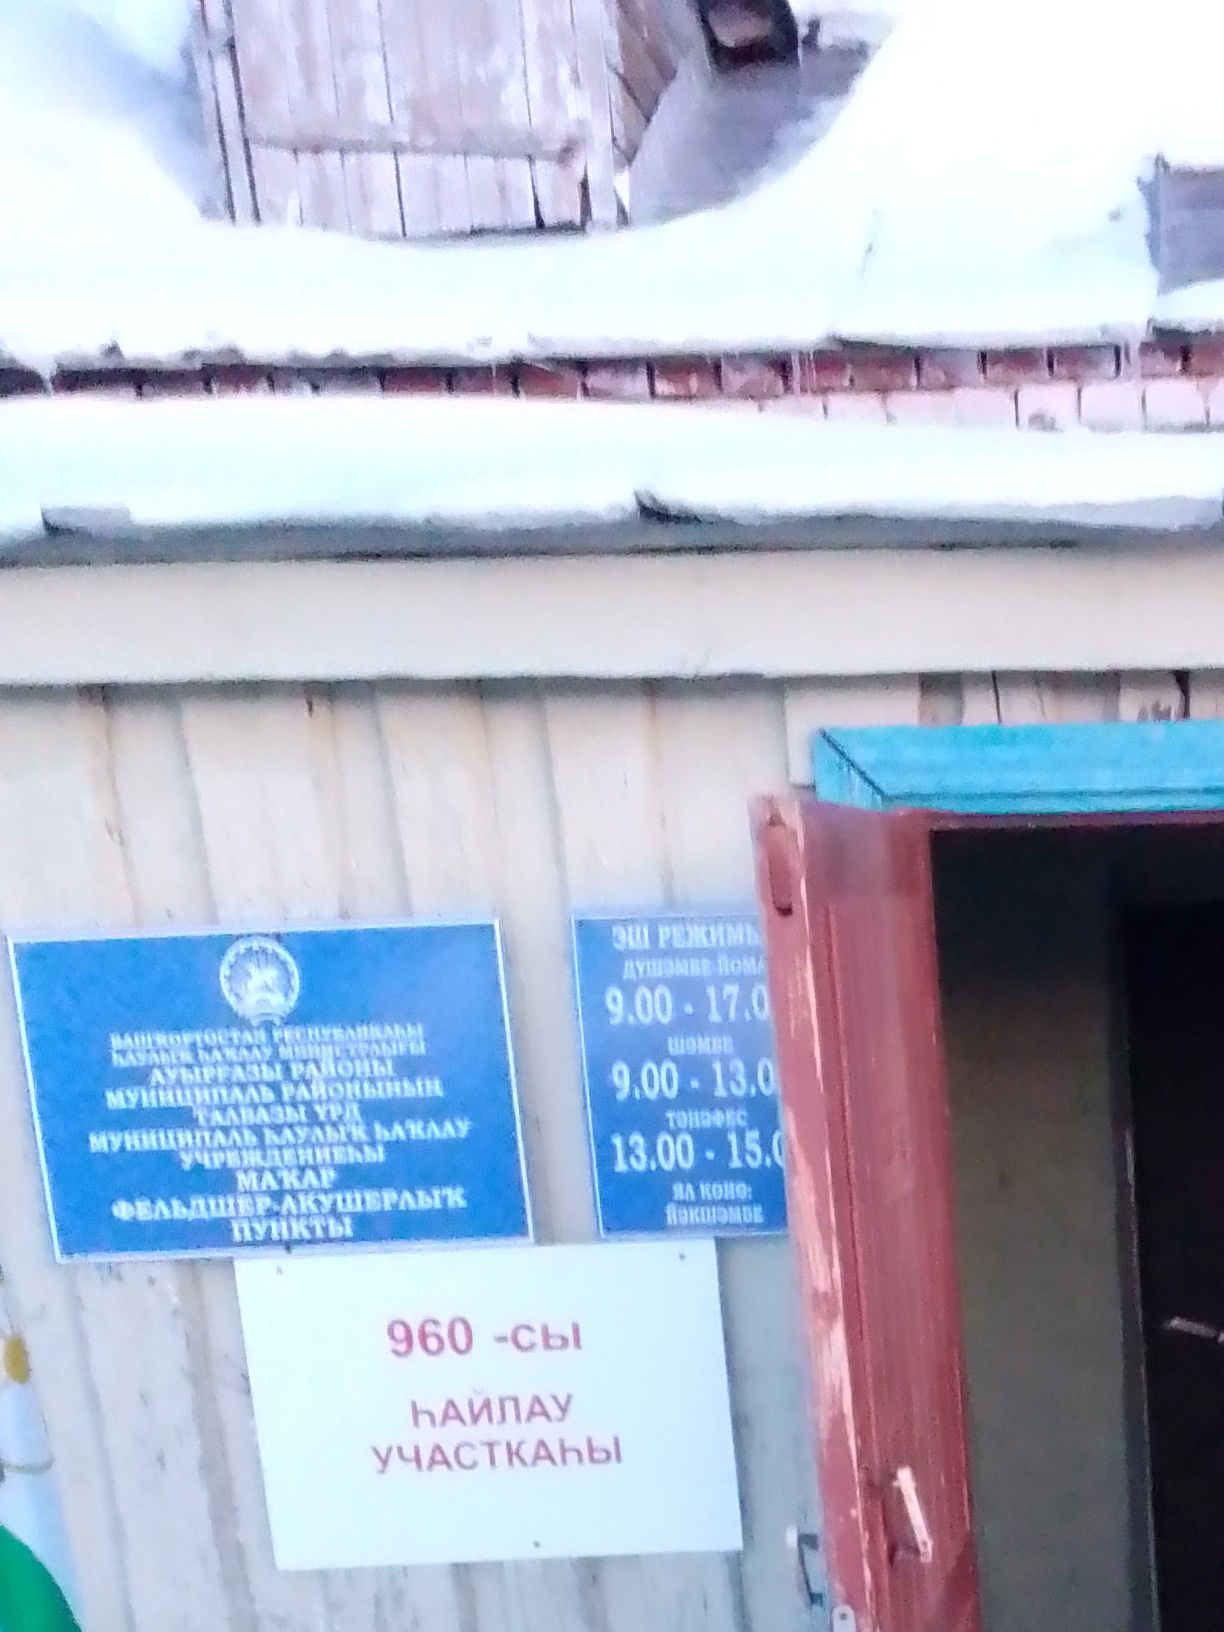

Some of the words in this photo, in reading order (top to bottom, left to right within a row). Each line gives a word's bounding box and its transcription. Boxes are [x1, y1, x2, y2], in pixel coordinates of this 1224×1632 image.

[611, 924, 650, 951] ЭШ
[605, 985, 673, 1026] 9.00
[706, 983, 770, 1024] 17.0
[289, 1056, 395, 1081] РАЙОНЫ
[611, 1060, 679, 1101] 9.00
[712, 1057, 775, 1099] 13.0
[610, 1130, 695, 1174] 13.00
[727, 1129, 784, 1169] 15.0
[672, 1182, 696, 1202] ЯЛ
[231, 1214, 355, 1242] ПУНКТЫ
[386, 1315, 474, 1358] 960
